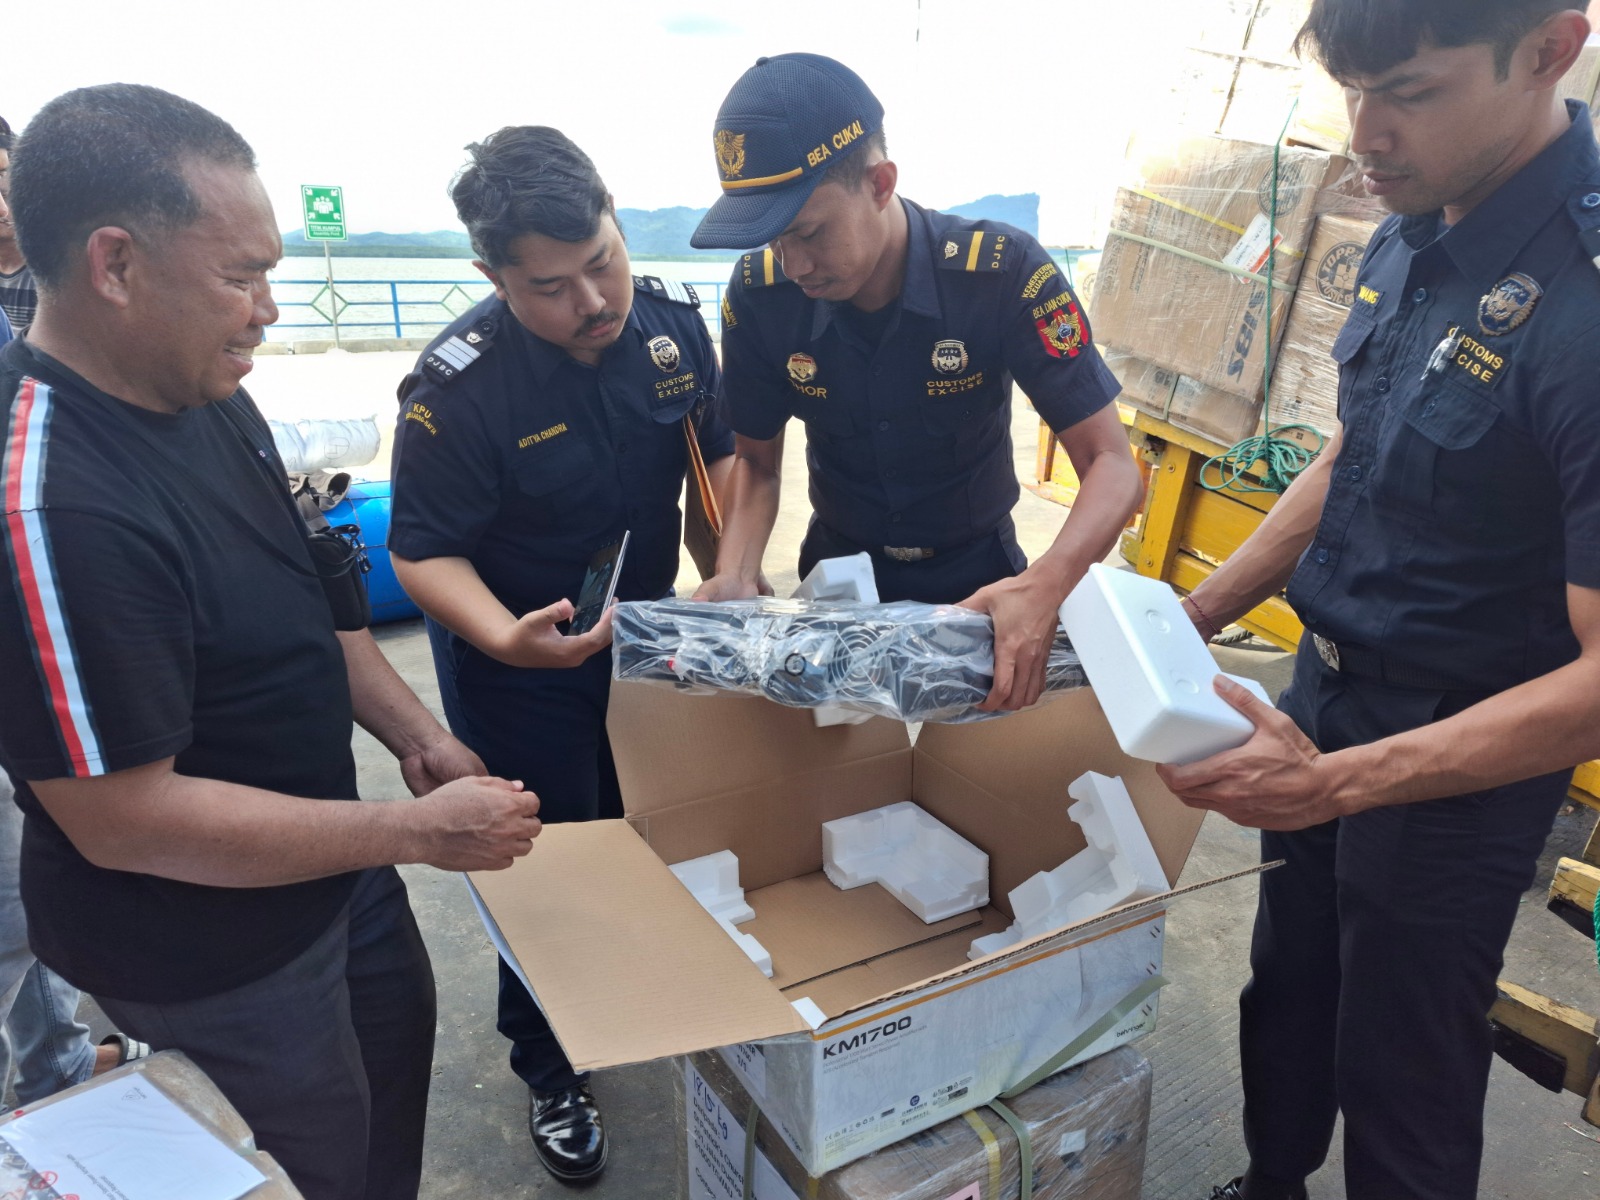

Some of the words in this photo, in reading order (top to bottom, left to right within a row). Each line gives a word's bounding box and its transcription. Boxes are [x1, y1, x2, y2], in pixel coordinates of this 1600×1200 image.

[807, 144, 832, 168] BEA
[832, 120, 864, 149] CUKAI
[991, 235, 1005, 269] DJBC
[1321, 246, 1356, 273] TOPP
[743, 255, 752, 285] DJBC
[1021, 262, 1055, 298] KEMENTERIAN
[1028, 266, 1057, 299] KEUANGAN
[1032, 306, 1045, 319] BEA
[427, 357, 453, 376] DJBC
[926, 372, 982, 387] CUSTOMS
[1456, 350, 1494, 383] CISE
[655, 372, 694, 389] CUSTOMS
[658, 382, 695, 398] EXCISE
[928, 377, 983, 396] EXCISE
[413, 403, 432, 419] KPU
[518, 433, 541, 448] ADITYA
[540, 422, 567, 440] CHANDRA
[823, 1016, 912, 1060] KM1700
[717, 1105, 728, 1140] kg
